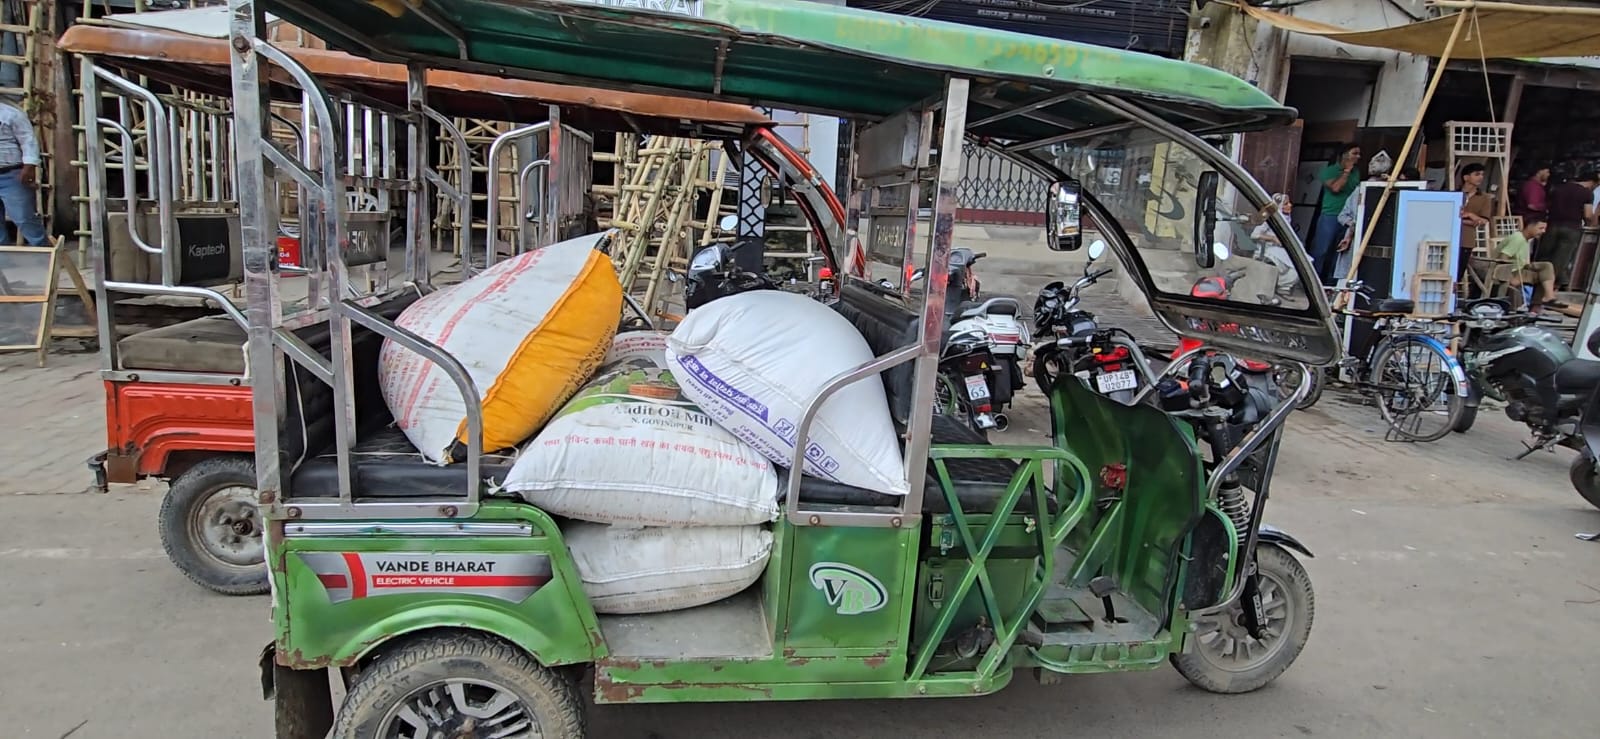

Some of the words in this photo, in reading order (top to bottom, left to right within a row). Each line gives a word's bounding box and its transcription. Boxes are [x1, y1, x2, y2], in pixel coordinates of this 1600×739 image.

[188, 243, 225, 258] Kaptech
[685, 411, 713, 427] Mill
[376, 560, 429, 572] VANDE
[434, 561, 496, 573] BHARAT
[376, 577, 417, 585] ELECTRIC
[419, 577, 454, 585] VEHICLE
